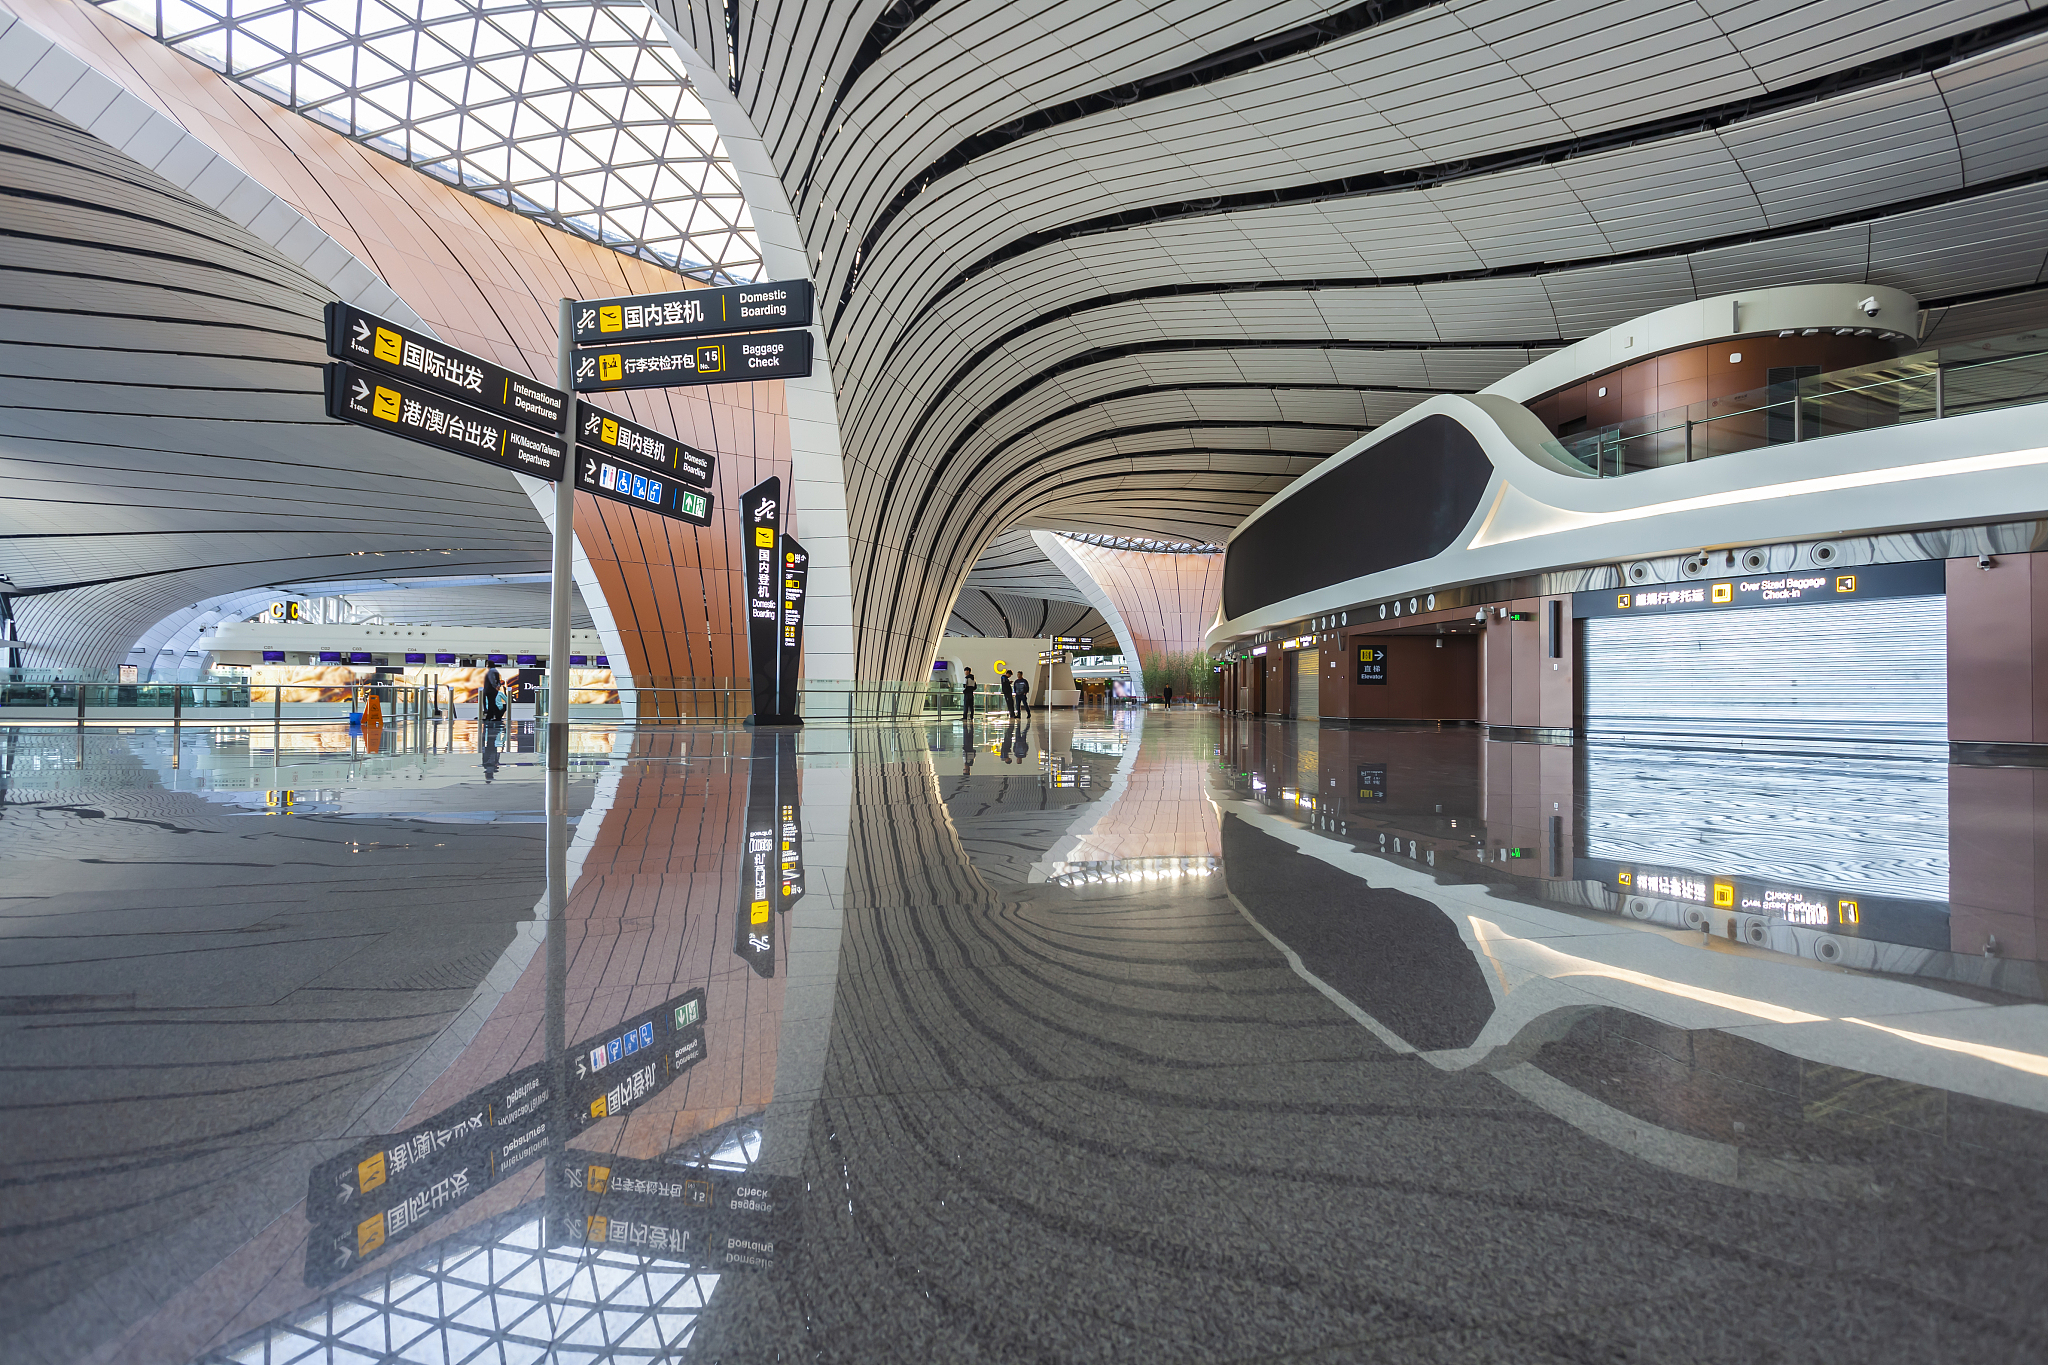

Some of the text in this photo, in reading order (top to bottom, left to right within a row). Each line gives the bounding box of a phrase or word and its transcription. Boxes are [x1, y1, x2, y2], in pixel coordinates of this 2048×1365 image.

[740, 290, 787, 304] Domestic
[624, 300, 704, 329] 国内登机
[741, 304, 787, 317] Boarding
[355, 345, 370, 355] 140m
[705, 350, 718, 362] 15
[742, 344, 784, 356] Baggage
[402, 340, 484, 393] 国际出发
[624, 354, 696, 374] 行李安检开包
[748, 356, 780, 368] Check
[514, 382, 561, 408] International
[354, 404, 368, 414] 140m
[515, 396, 557, 420] Departures
[402, 398, 498, 451] 港/澳/台出发
[510, 432, 560, 458] HK/Macao/Taiwan
[618, 426, 666, 462] 国内登机
[518, 449, 550, 468] Departures
[684, 452, 708, 468] Domestic
[683, 462, 706, 480] Boarding
[758, 548, 770, 598] 国内登机
[1740, 582, 1760, 592] Over
[1761, 579, 1786, 590] Sized
[1786, 577, 1826, 589] Baggage
[1844, 579, 1852, 588] 1
[1762, 589, 1800, 600] Check-in
[270, 602, 298, 619] C C
[752, 598, 776, 609] Domestic
[752, 608, 775, 620] Boarding
[994, 660, 1006, 674] C
[1364, 665, 1381, 673] 直梯
